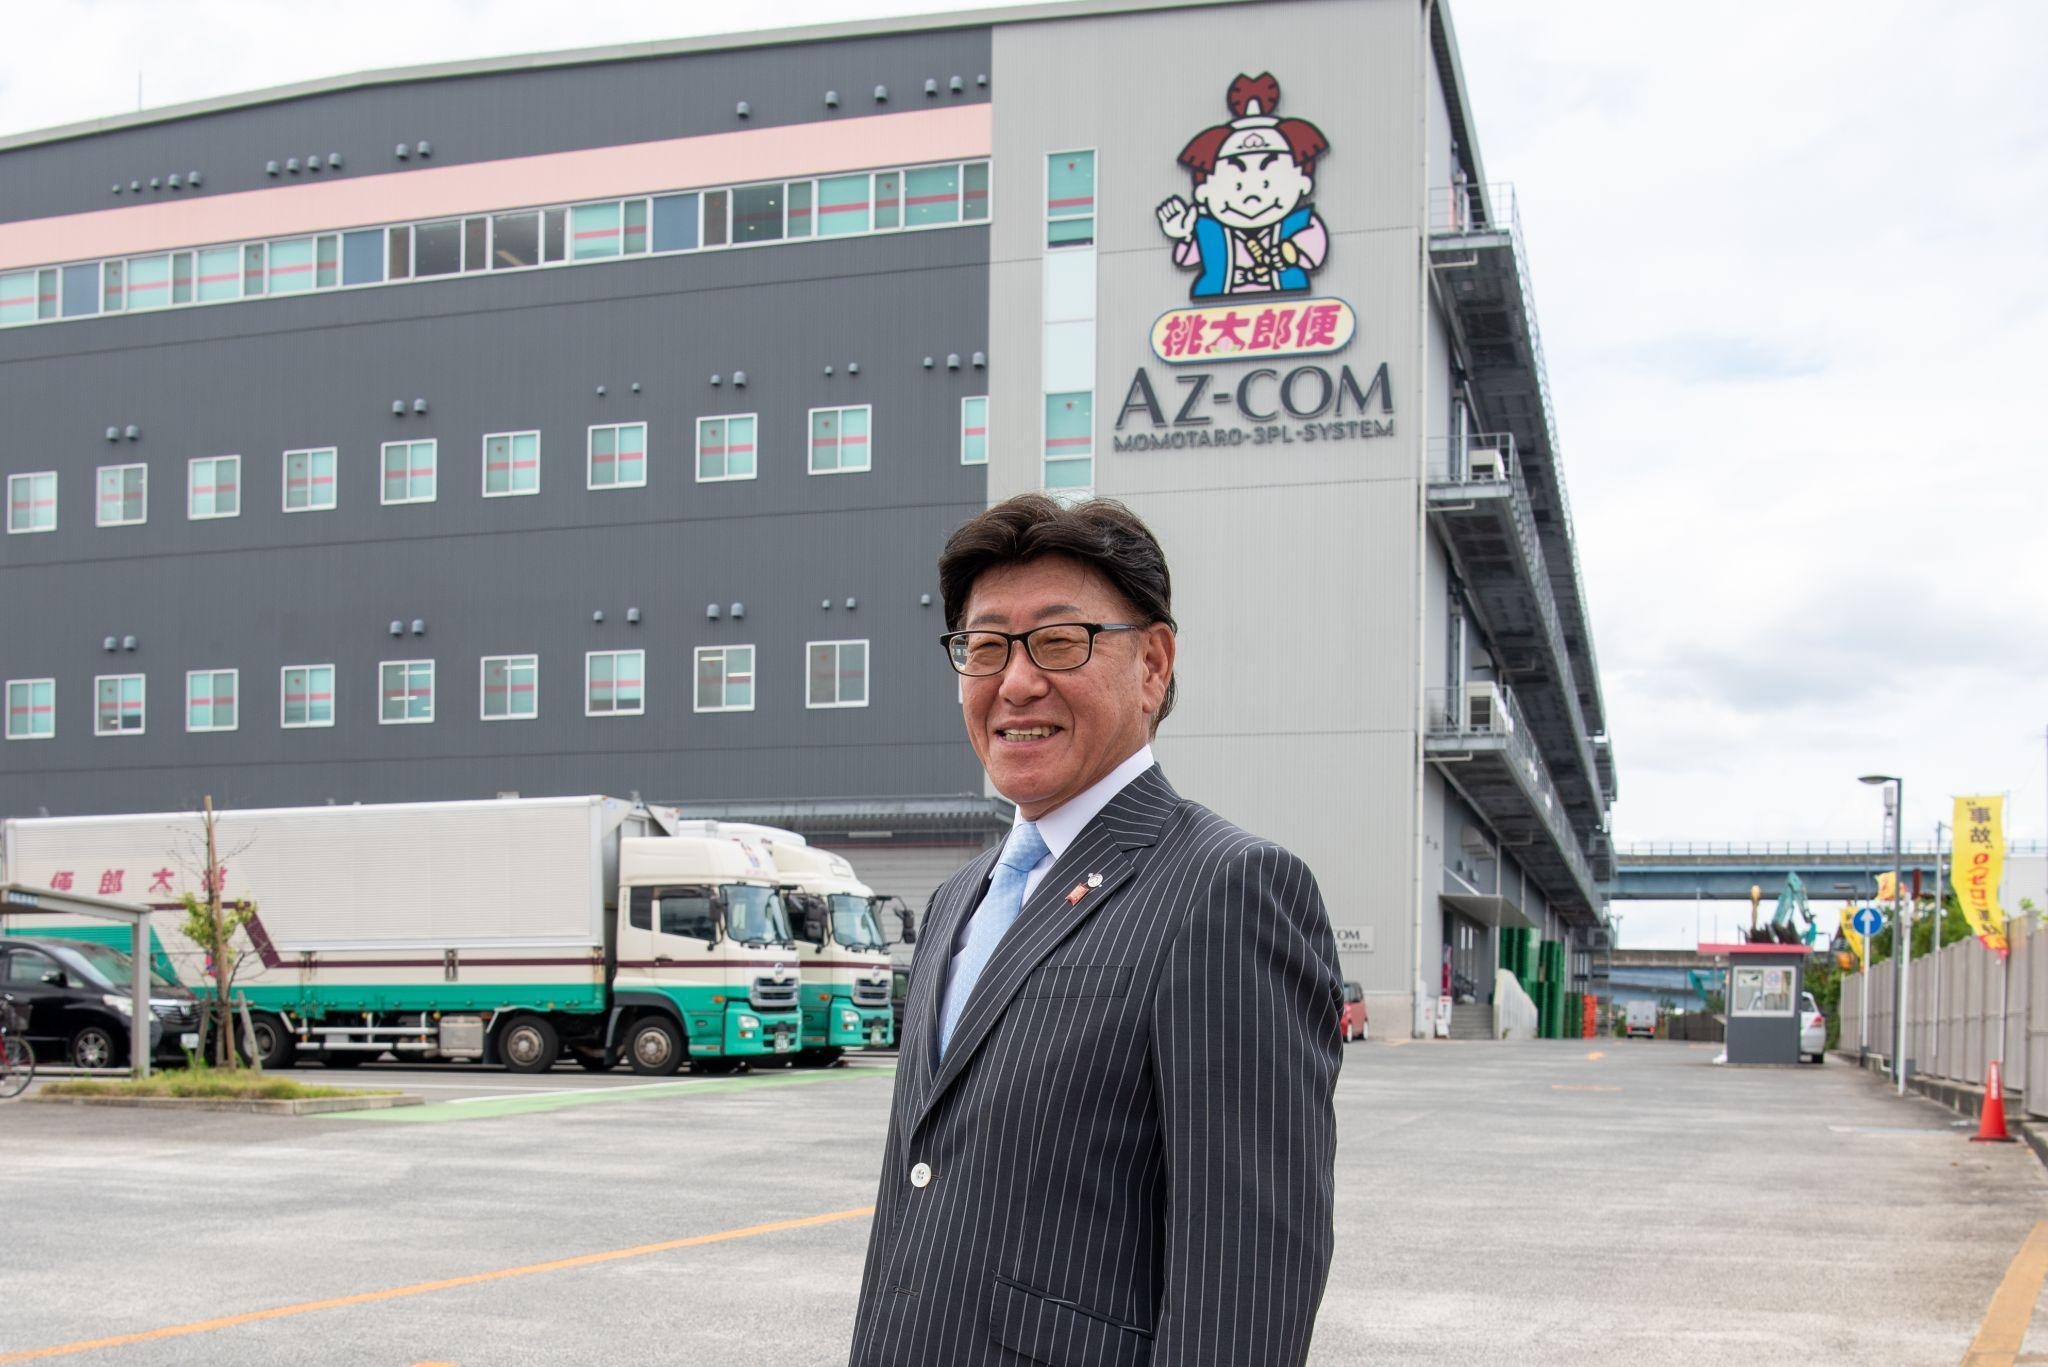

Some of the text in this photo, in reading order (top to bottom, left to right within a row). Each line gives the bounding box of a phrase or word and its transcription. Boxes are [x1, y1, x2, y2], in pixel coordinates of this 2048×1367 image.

[1161, 304, 1342, 357] 桃太郎便
[1114, 361, 1395, 430] AZ-COM
